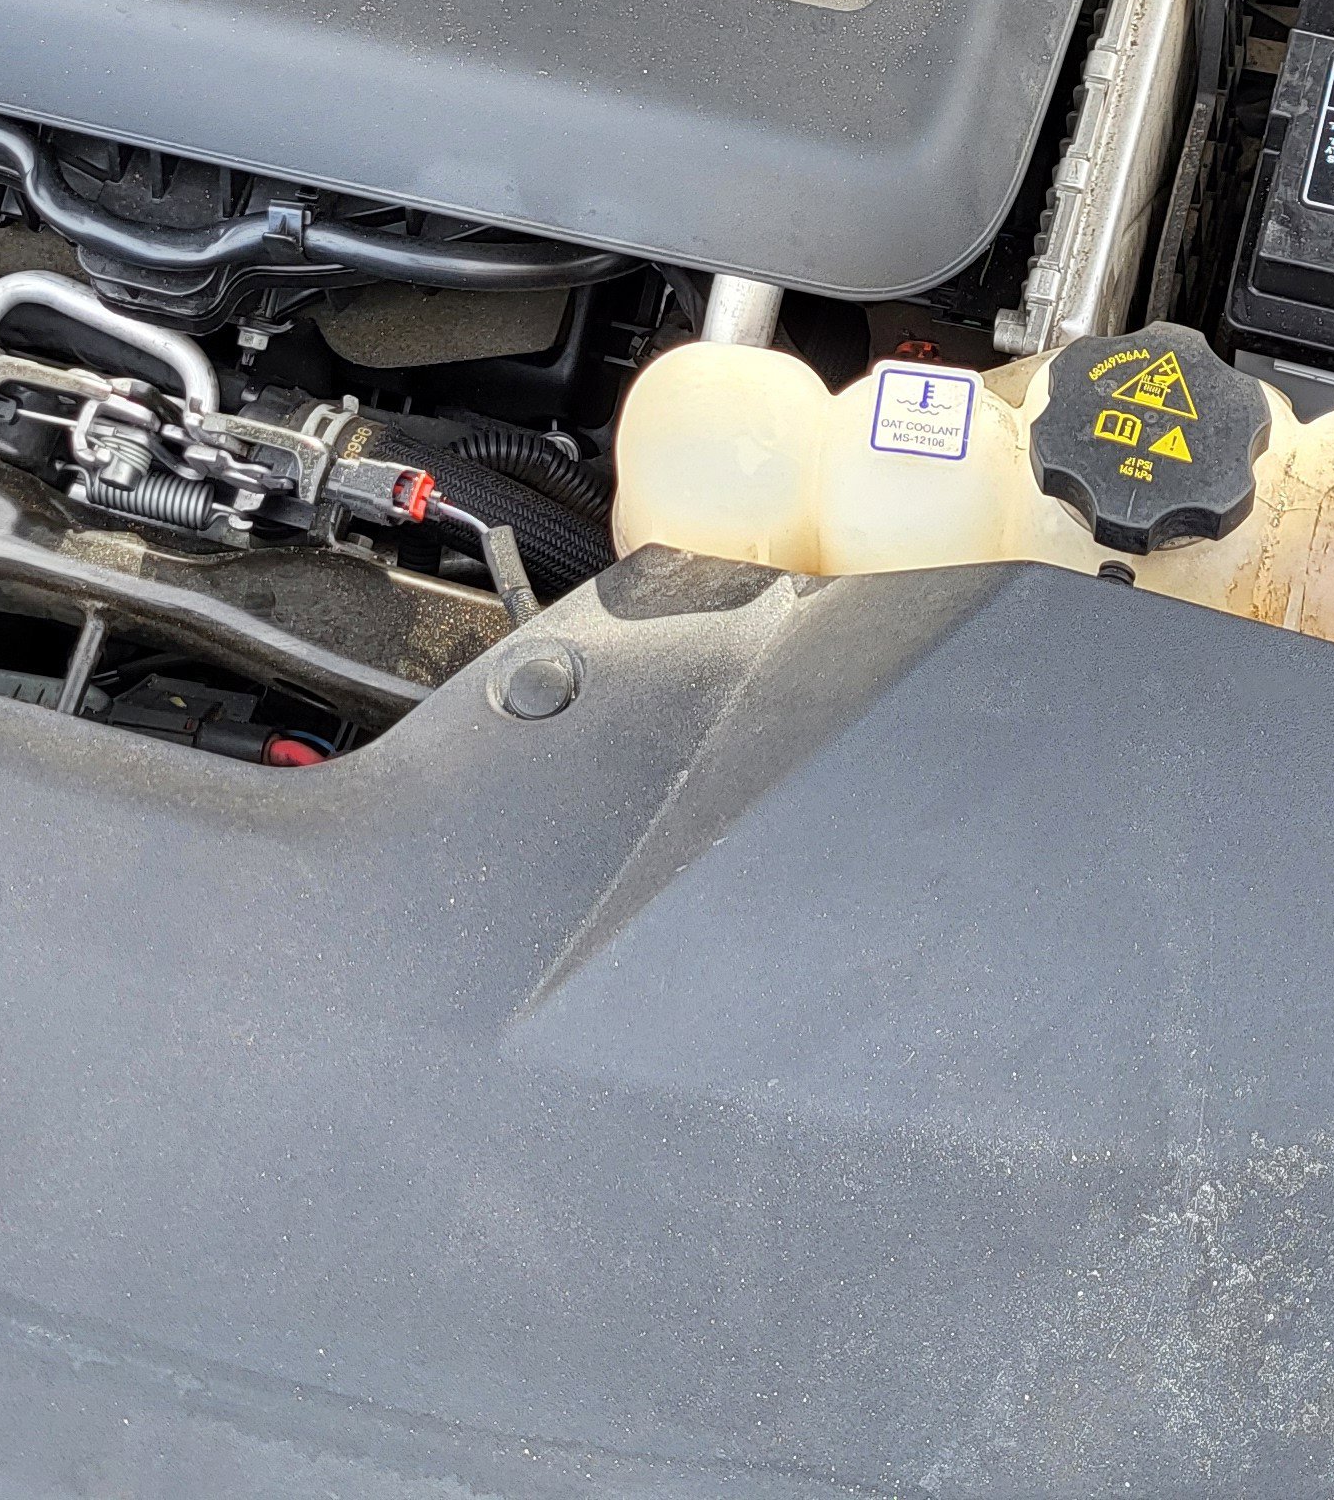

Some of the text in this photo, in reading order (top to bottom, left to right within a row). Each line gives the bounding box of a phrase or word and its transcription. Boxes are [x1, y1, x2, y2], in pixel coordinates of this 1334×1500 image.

[1088, 348, 1150, 381] 68249136AA
[881, 418, 961, 437] OAT COOLANT
[893, 432, 945, 447] MS-12106
[1125, 456, 1153, 470] 21 PSI
[1135, 468, 1153, 482] kPa
